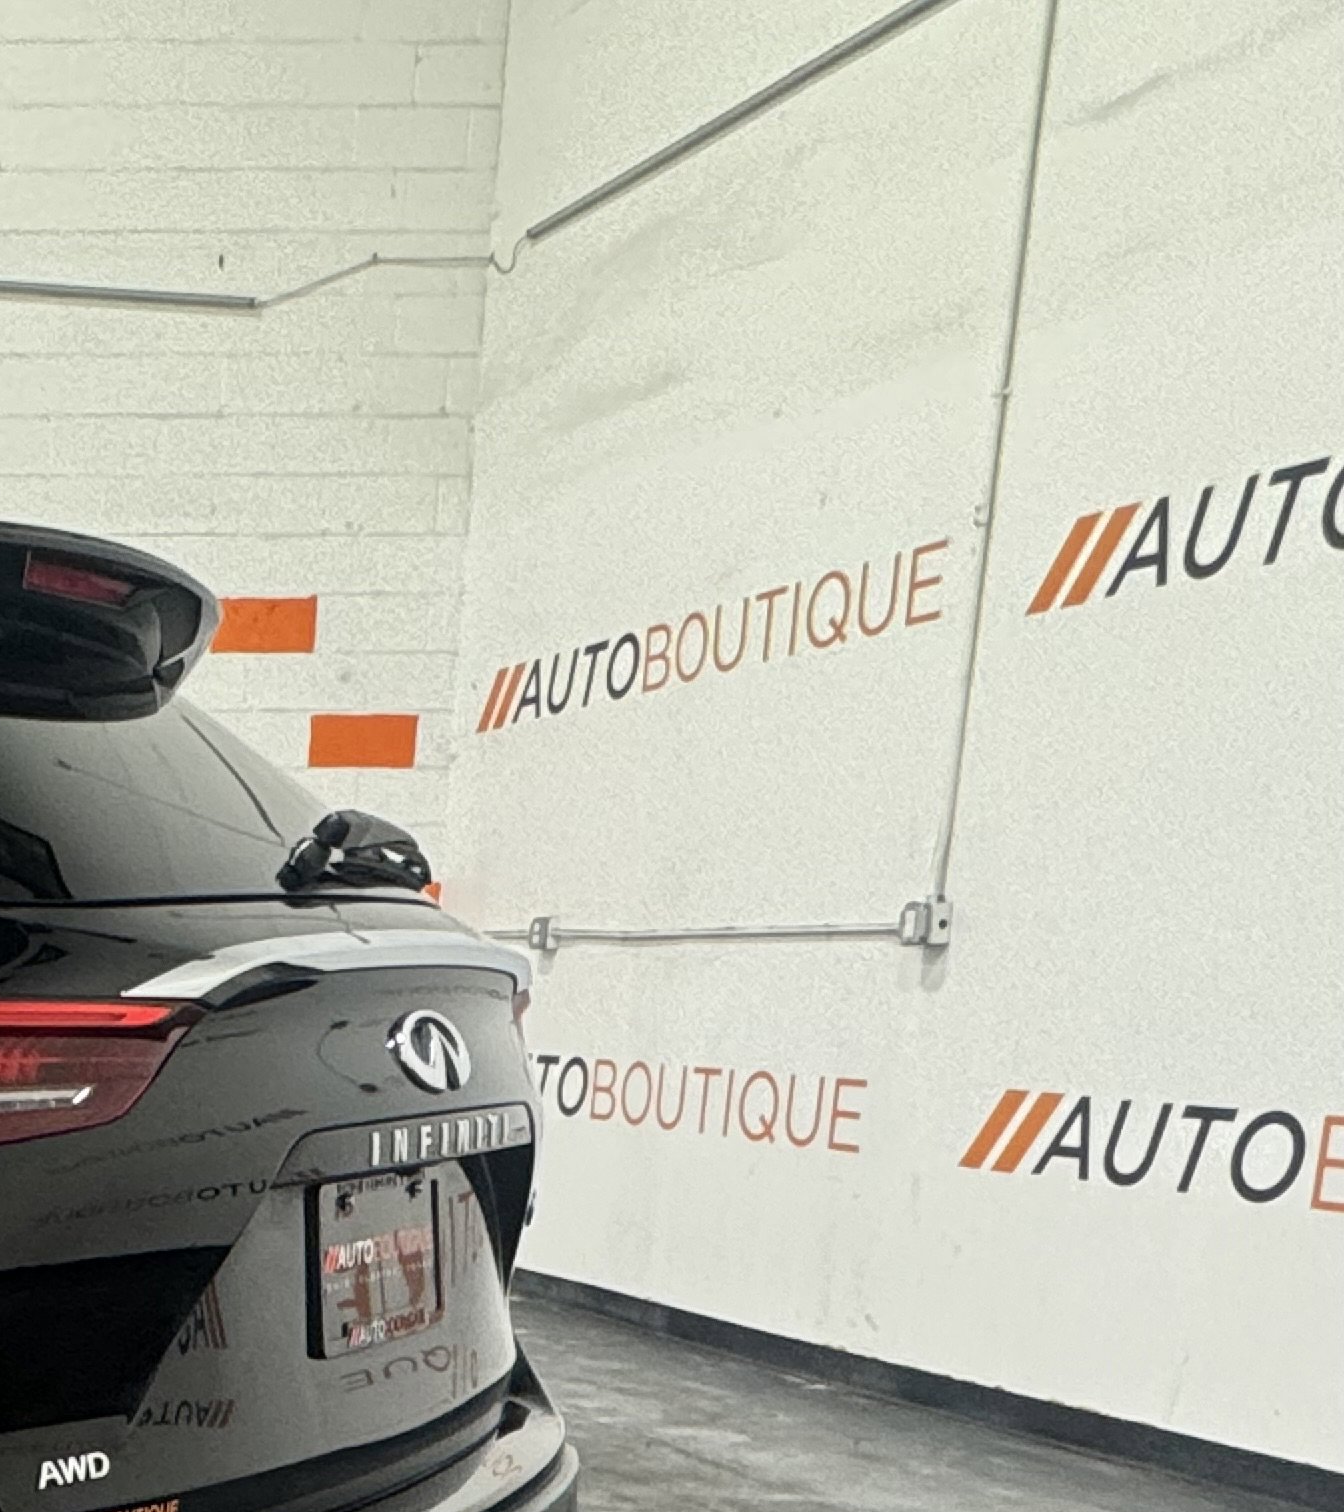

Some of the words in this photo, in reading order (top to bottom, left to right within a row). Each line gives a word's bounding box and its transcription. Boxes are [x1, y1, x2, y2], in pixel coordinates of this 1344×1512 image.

[1105, 455, 1344, 598] AUT
[513, 537, 950, 724] AUTOBOUTIQUE
[370, 1113, 510, 1167] INFINITI
[38, 1450, 111, 1490] AWD
